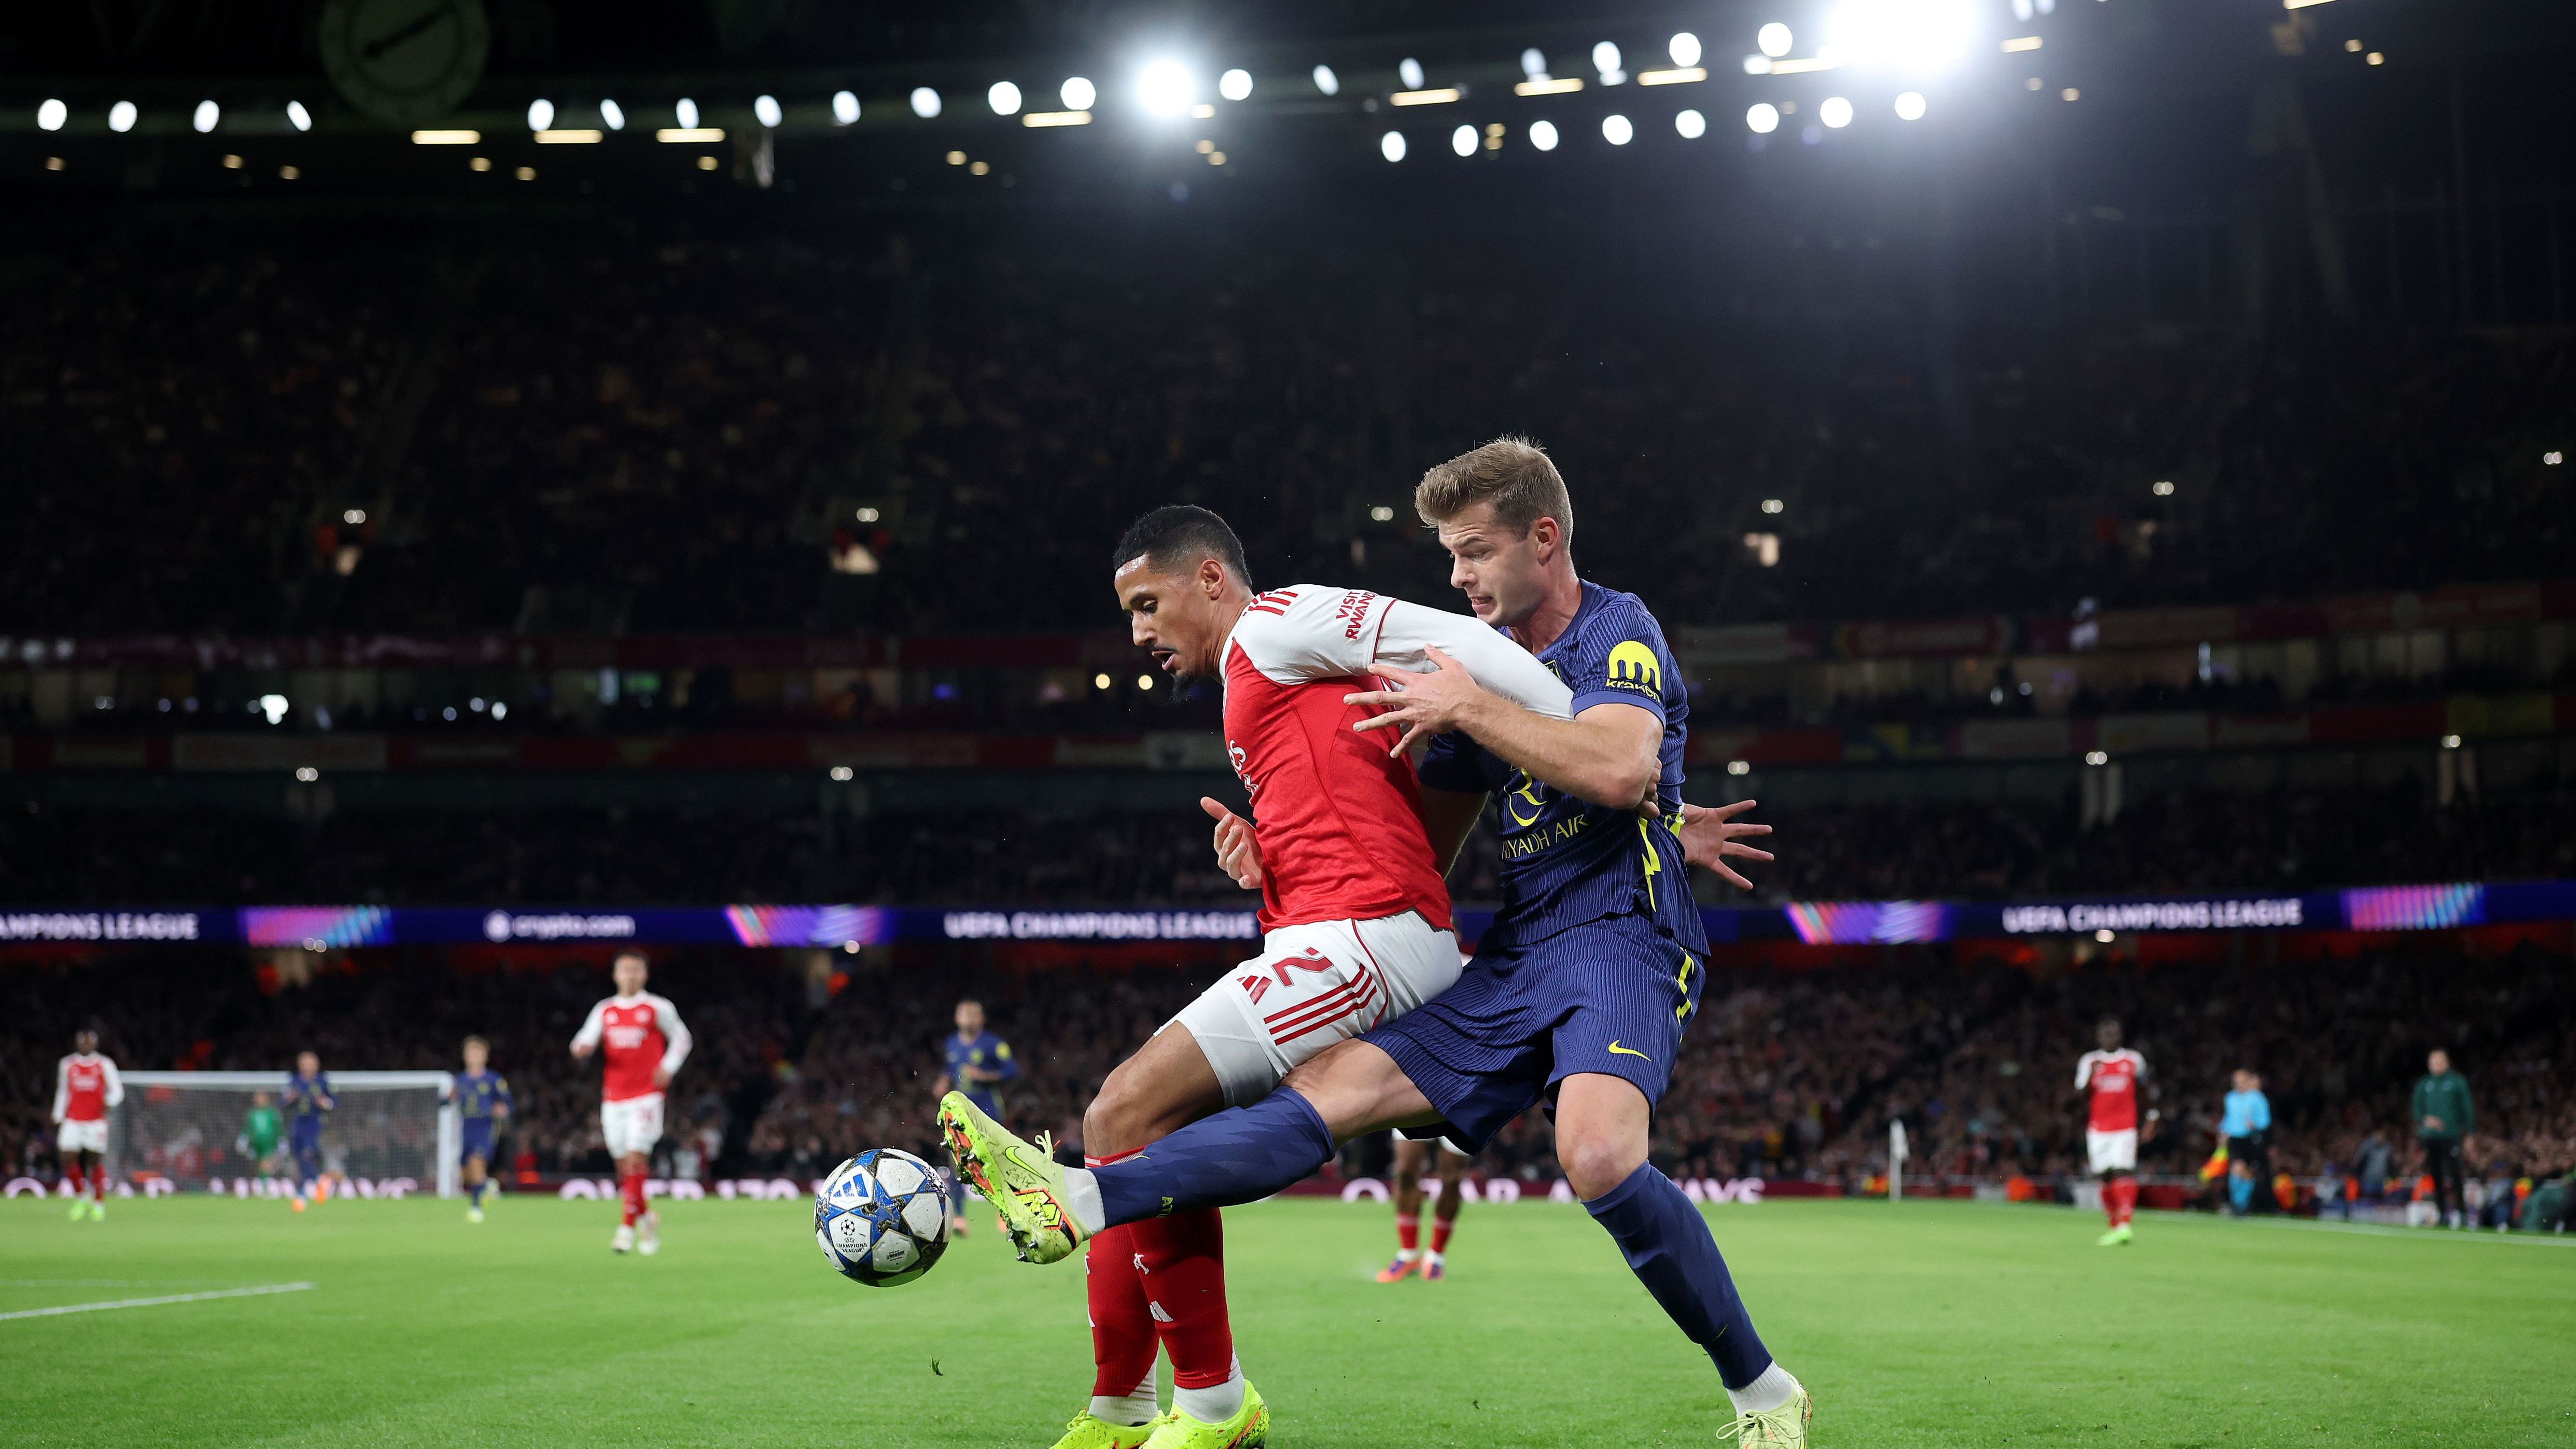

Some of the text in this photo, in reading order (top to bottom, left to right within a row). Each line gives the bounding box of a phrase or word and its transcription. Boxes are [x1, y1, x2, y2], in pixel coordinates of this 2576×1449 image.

[1336, 592, 1361, 618] VISIT
[1345, 591, 1378, 640] RWAND
[1606, 679, 1660, 703] kraken
[1502, 814, 1590, 860] RIYADH AIR
[104, 912, 199, 939] LEAGUE
[512, 912, 636, 940] crypto.com
[944, 912, 1258, 938] UEFA CHAMPIONS LEAGUE
[2002, 898, 2303, 933] UEFA CHAMPIONS LEAGUE
[1270, 946, 1334, 988] 2
